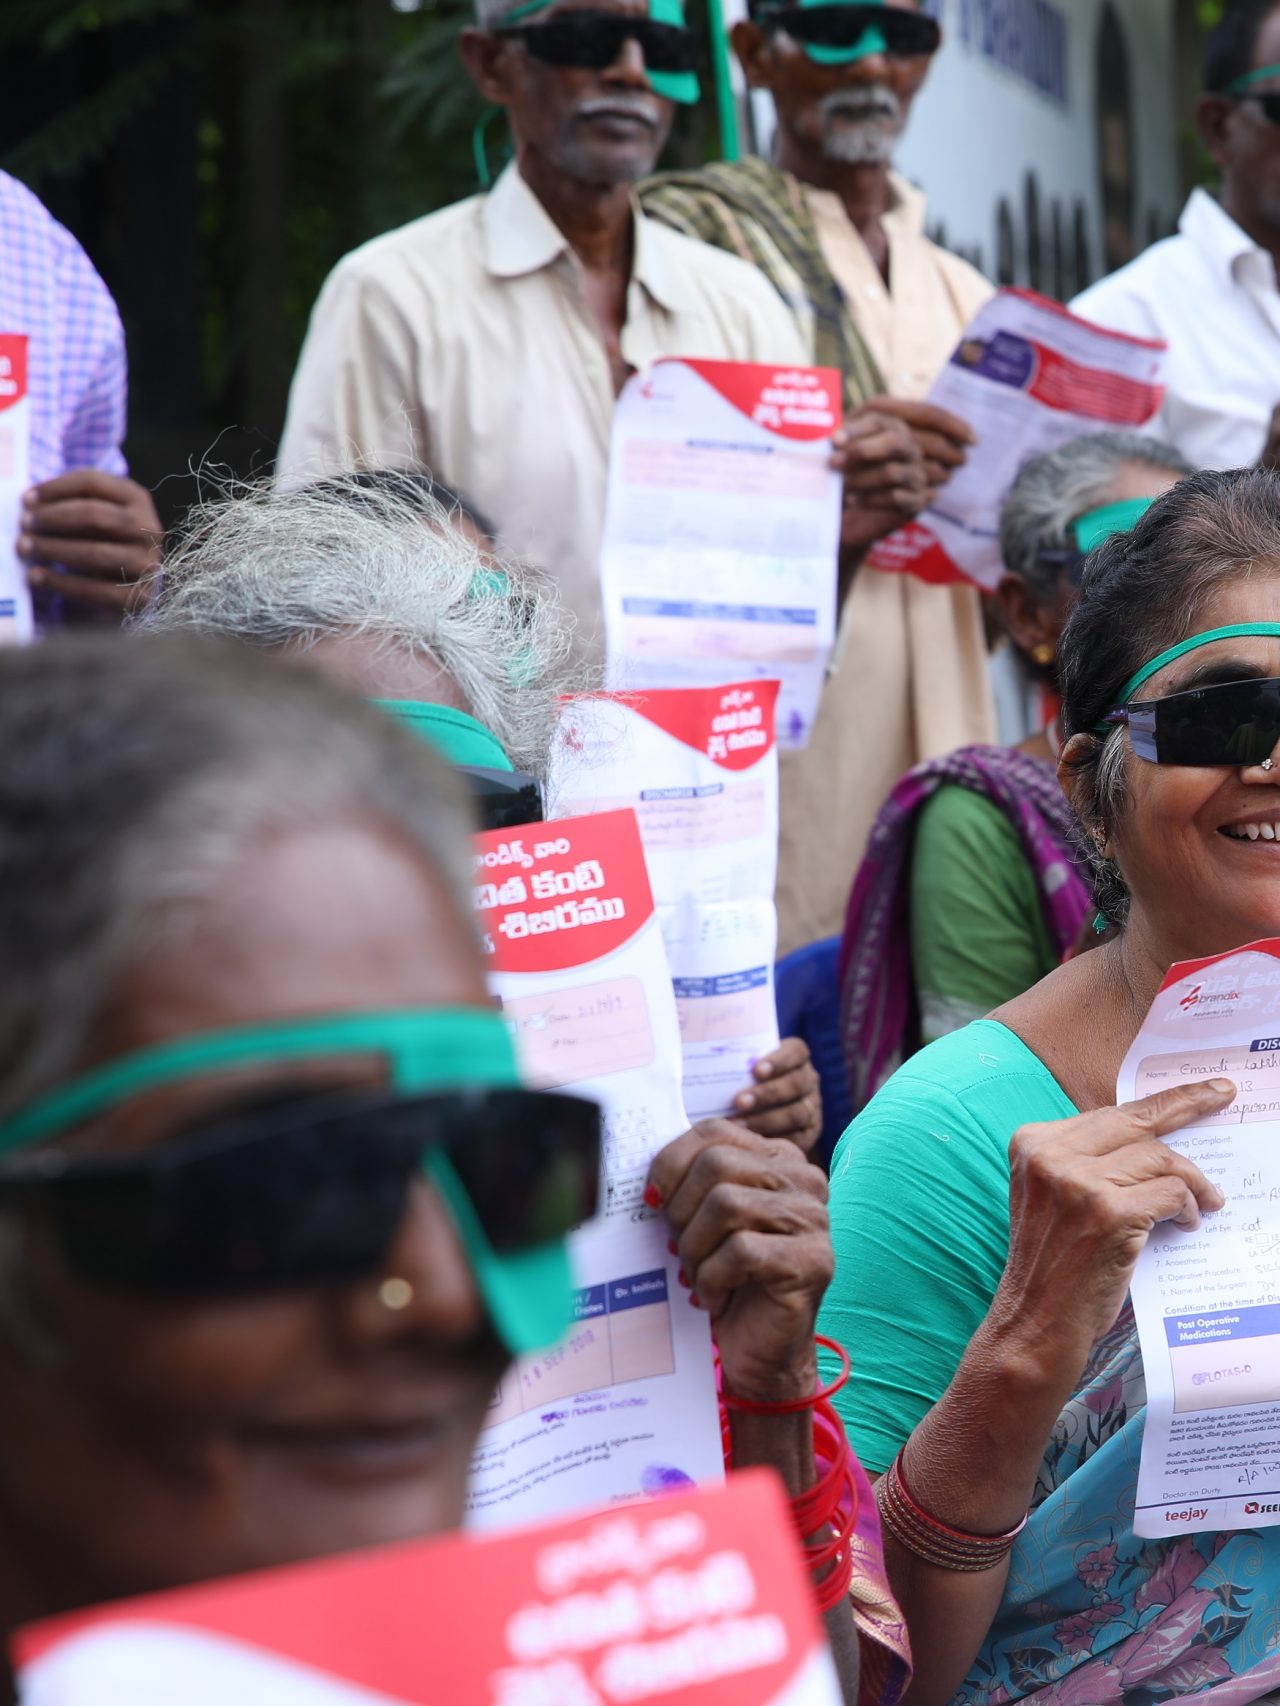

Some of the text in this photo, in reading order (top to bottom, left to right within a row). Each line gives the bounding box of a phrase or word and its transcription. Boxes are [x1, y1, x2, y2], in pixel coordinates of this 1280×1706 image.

[533, 837, 571, 860] వారి
[530, 859, 605, 899] కంటి
[499, 897, 626, 939] శిబిరము
[1199, 991, 1242, 1004] brandix
[1192, 1136, 1233, 1147] Complaint:
[1200, 1151, 1234, 1161] Admission
[1219, 1224, 1232, 1233] Eye
[1162, 1242, 1197, 1253] Operated
[1198, 1241, 1211, 1251] Eye
[1168, 1271, 1203, 1282] Operative
[1205, 1267, 1240, 1277] Procedure
[1171, 1286, 1194, 1296] Name
[1204, 1284, 1215, 1292] the
[1216, 1280, 1247, 1292] Surgeon
[1165, 1304, 1207, 1315] Condition
[1209, 1302, 1218, 1310] at
[1219, 1299, 1234, 1309] the
[1236, 1297, 1254, 1307] time
[1257, 1295, 1267, 1304] of
[1177, 1315, 1240, 1330] Post Operative
[1179, 1328, 1232, 1341] Medications
[1163, 1490, 1188, 1499] Doctor
[1165, 1508, 1209, 1522] teejay
